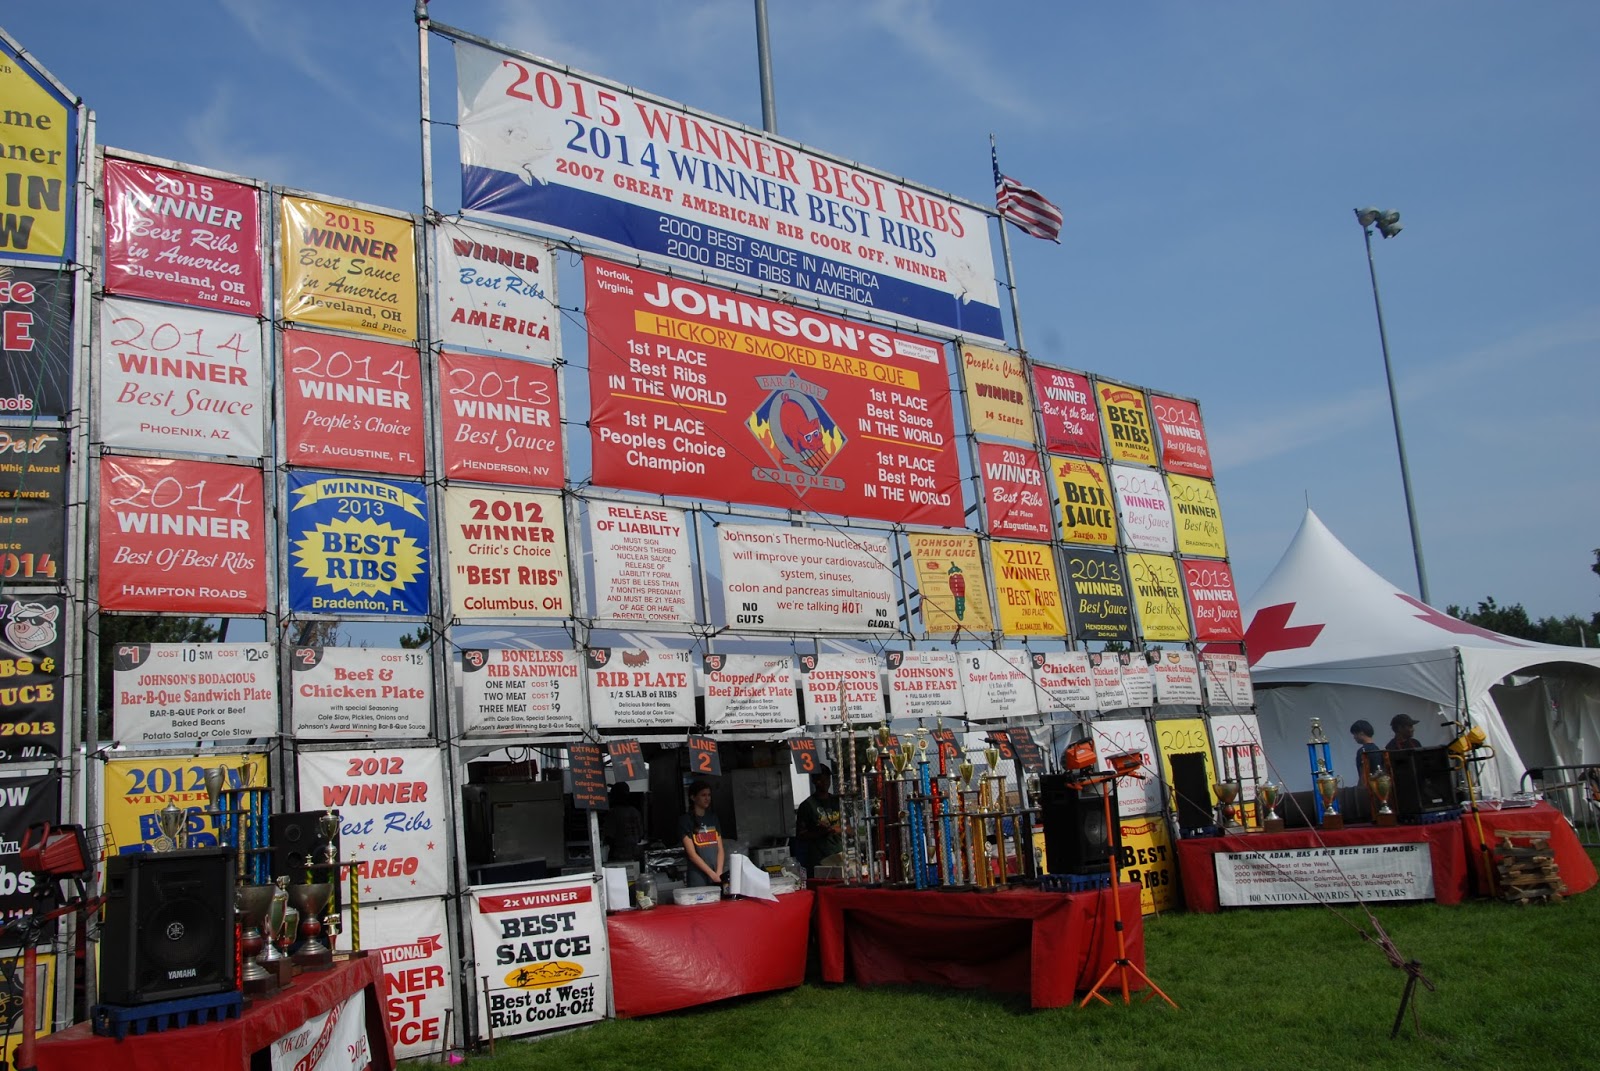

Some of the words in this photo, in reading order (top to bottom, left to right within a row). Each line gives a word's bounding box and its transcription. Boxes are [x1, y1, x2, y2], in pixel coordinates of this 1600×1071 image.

[503, 60, 621, 127] 2015
[634, 102, 800, 185] WINNER
[807, 158, 887, 213] BEST
[895, 188, 965, 239] RIBS
[155, 175, 214, 201] 2015
[565, 119, 661, 180] 2014
[668, 150, 799, 217] WINNER
[806, 193, 870, 238] BEST
[879, 216, 936, 259] RIBS
[324, 211, 375, 235] 2015
[131, 218, 182, 241] Best
[190, 229, 239, 254] Ribs
[302, 227, 399, 262] WINNER
[299, 248, 340, 271] Best
[347, 259, 400, 283] Sauce
[667, 239, 710, 264] 2000
[715, 251, 753, 275] BEST
[758, 264, 791, 285] RIBS
[796, 273, 809, 289] IN
[815, 278, 873, 306] AMERICA
[459, 268, 502, 290] Best
[505, 275, 545, 300] Ribs
[198, 291, 217, 302] 2nd
[223, 295, 251, 307] Place
[497, 300, 507, 308] in
[299, 295, 376, 318] Cleveland,
[381, 309, 402, 322] OH
[361, 319, 378, 330] 2nd
[382, 323, 407, 335] Place
[451, 307, 550, 341] AMERICA
[111, 318, 250, 364] 2014
[627, 339, 650, 357] 1st
[657, 344, 708, 367] PLACE
[118, 353, 249, 386] WINNER
[298, 379, 411, 410] WINNER
[608, 375, 626, 390] IN
[632, 378, 665, 396] THE
[671, 384, 727, 406] WORLD
[975, 382, 1024, 405] WINNER
[1044, 386, 1087, 405] WINNER
[869, 388, 887, 403] 1st
[891, 392, 928, 412] PLACE
[453, 399, 551, 427] WINNER
[985, 411, 995, 420] 14
[998, 413, 1024, 426] States
[1107, 405, 1143, 427] BEST
[624, 411, 647, 428] 1st
[654, 415, 705, 436] PLACE
[858, 418, 872, 433] IN
[875, 421, 899, 438] THE
[902, 427, 943, 446] WORLD
[1162, 423, 1202, 441] WINNER
[1111, 423, 1149, 445] RIBS
[876, 451, 894, 467] 1st
[898, 454, 935, 473] PLACE
[1002, 450, 1025, 466] 2013
[878, 468, 906, 485] Best
[909, 472, 936, 489] Pork
[985, 462, 1041, 486] WINNER
[110, 475, 252, 517] 2014
[338, 499, 385, 517] 2013
[469, 499, 544, 524] 2012
[116, 512, 251, 540] WINNER
[597, 520, 615, 531] OF
[618, 523, 680, 538] LIABILITY
[1128, 511, 1145, 524] Best
[1145, 514, 1170, 530] Sauce
[1184, 519, 1202, 532] Best
[1203, 521, 1218, 537] Ribs
[460, 524, 555, 544] WINNER
[322, 532, 400, 556] BEST
[468, 543, 509, 556] Critic's
[513, 545, 551, 557] Choice
[733, 551, 752, 560] will
[756, 551, 799, 564] improve
[801, 555, 823, 565] your
[825, 557, 886, 570] cardiovascular
[917, 549, 941, 557] PAIN
[945, 549, 976, 558] GAUGE
[1004, 550, 1043, 566] 2012
[326, 558, 397, 582] RIBS
[1001, 565, 1051, 581] WINNER
[1070, 559, 1121, 582] 2013
[1188, 569, 1231, 588] 2013
[122, 584, 197, 597] HAMPTON
[199, 587, 247, 599] ROADS
[729, 583, 760, 593] colon
[763, 584, 783, 594] and
[785, 586, 829, 597] pancreas
[831, 587, 891, 602] simultaniously
[1075, 581, 1124, 597] WINNER
[1138, 585, 1179, 598] WINNER
[1192, 589, 1234, 602] WINNER
[312, 597, 389, 612] Bradenton,
[392, 599, 409, 612] FL
[463, 596, 538, 611] Columbus,
[542, 597, 563, 610] OH
[742, 602, 758, 612] NO
[1145, 601, 1163, 614] Best
[736, 614, 764, 624] GUTS
[876, 609, 887, 618] NO
[867, 620, 895, 629] GLORY
[487, 664, 512, 677] RIB
[512, 664, 578, 678] SANDWICH
[895, 668, 954, 678] JOHNSON'S
[1042, 663, 1086, 674] Chicken
[137, 674, 197, 686] JOHNSON'S
[198, 672, 255, 684] BODACIOUS
[485, 680, 503, 689] ONE
[505, 680, 526, 689] MEAT
[550, 680, 560, 690] $5
[596, 671, 629, 687] RIB
[634, 672, 688, 688] PLATE
[710, 671, 754, 685] Chopped
[755, 673, 777, 683] Pork
[778, 674, 789, 683] or
[894, 680, 925, 691] SLAB
[926, 680, 958, 690] FEAST
[1040, 676, 1091, 688] Sandwich
[300, 684, 377, 699] Chicken
[382, 685, 424, 699] Plate
[610, 691, 623, 699] 1/2
[625, 690, 648, 698] SLAB
[649, 690, 657, 698] of
[659, 691, 677, 699] RIBS
[709, 686, 732, 697] Beef
[733, 686, 766, 697] Brisket
[769, 686, 793, 697] Plate
[814, 694, 837, 703] RIB
[2, 721, 56, 736] 2013
[172, 719, 198, 728] Baked
[200, 718, 225, 727] Beans
[21, 746, 48, 758] MI.
[570, 745, 600, 754] EXTRAS
[609, 742, 640, 756] LINE
[790, 740, 816, 752] LINE
[322, 781, 427, 807] WINNER
[384, 811, 433, 834] Ribs
[1122, 845, 1167, 868] BEST
[503, 899, 520, 908] 2x
[522, 891, 578, 905] WINNER
[1249, 894, 1261, 902] 100
[1264, 892, 1309, 902] NATIONAL
[1313, 891, 1349, 901] AWARDS
[1375, 889, 1406, 898] YEARS
[500, 911, 576, 939] BEST
[496, 935, 591, 966] SAUCE
[168, 968, 196, 979] YAMAHA
